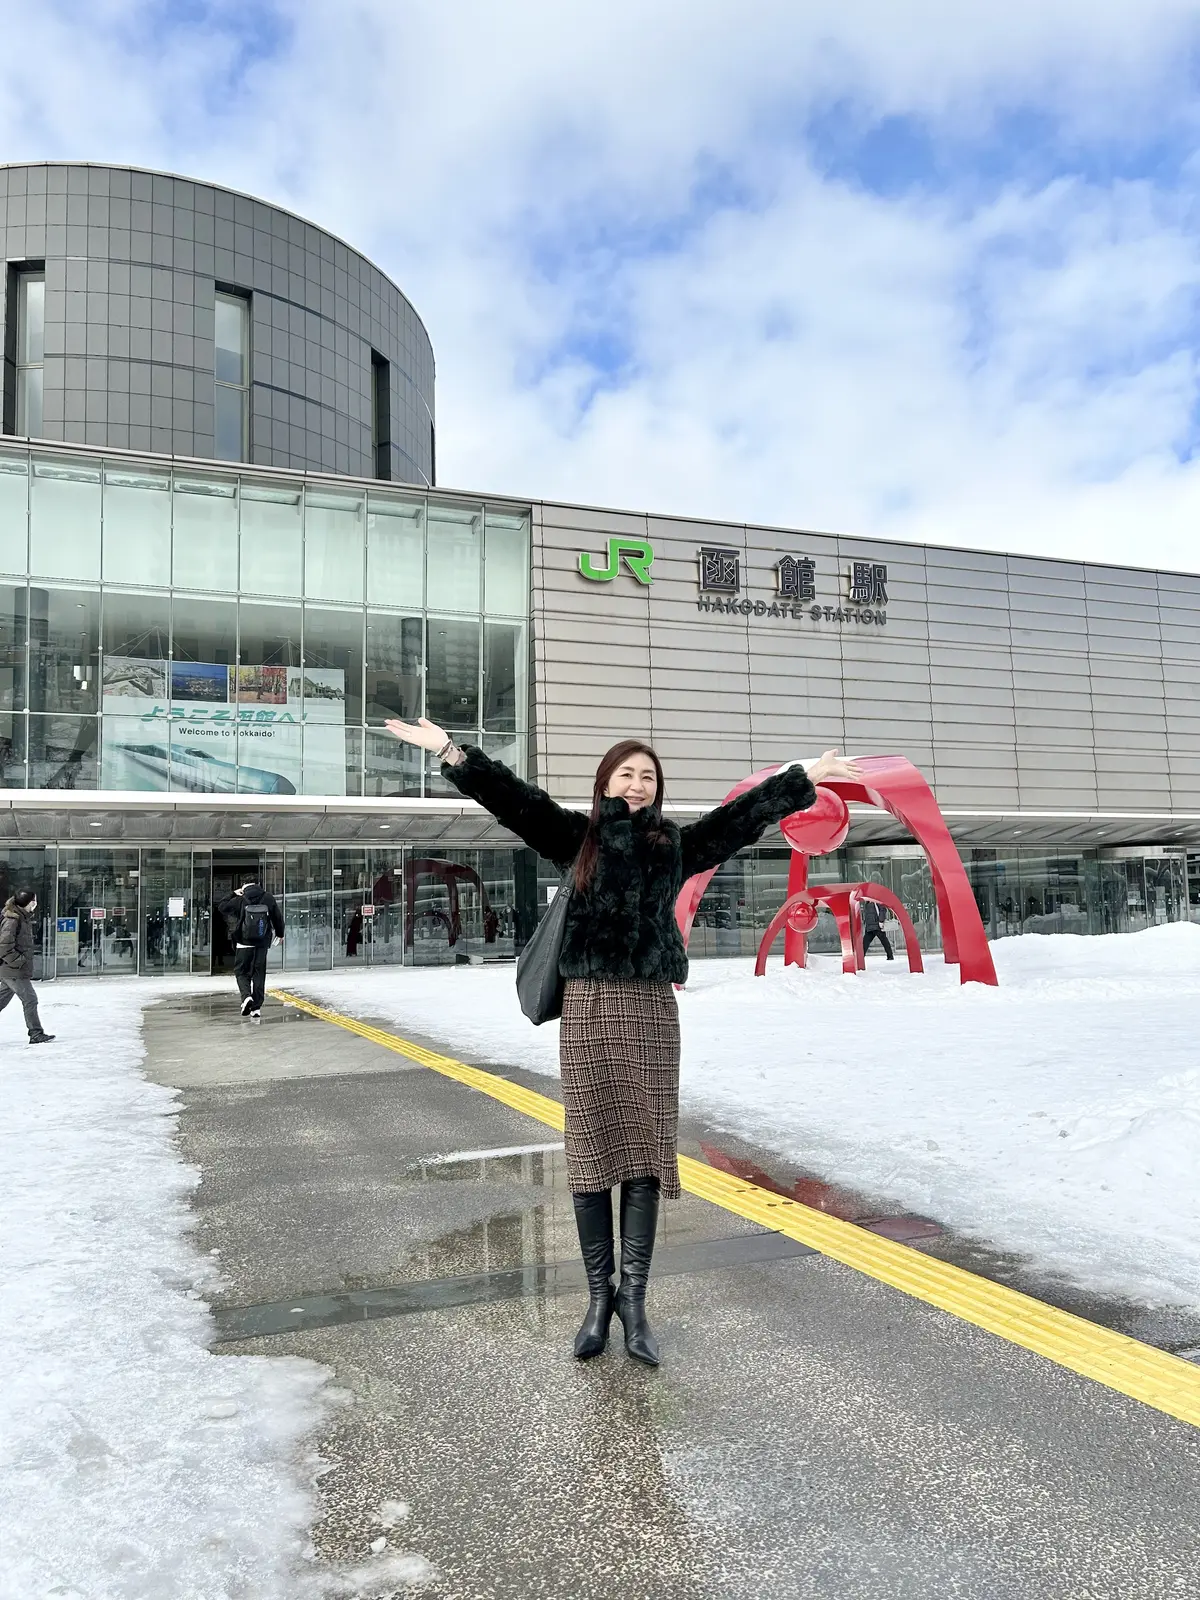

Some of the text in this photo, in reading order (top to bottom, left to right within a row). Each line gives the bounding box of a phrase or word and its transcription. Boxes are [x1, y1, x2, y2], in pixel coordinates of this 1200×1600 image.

[578, 538, 655, 585] JR
[698, 547, 889, 605] 函館駅
[697, 595, 887, 625] HAKODATE STATION
[179, 728, 219, 736] Welcome
[221, 729, 230, 737] to
[61, 921, 67, 931] 1
